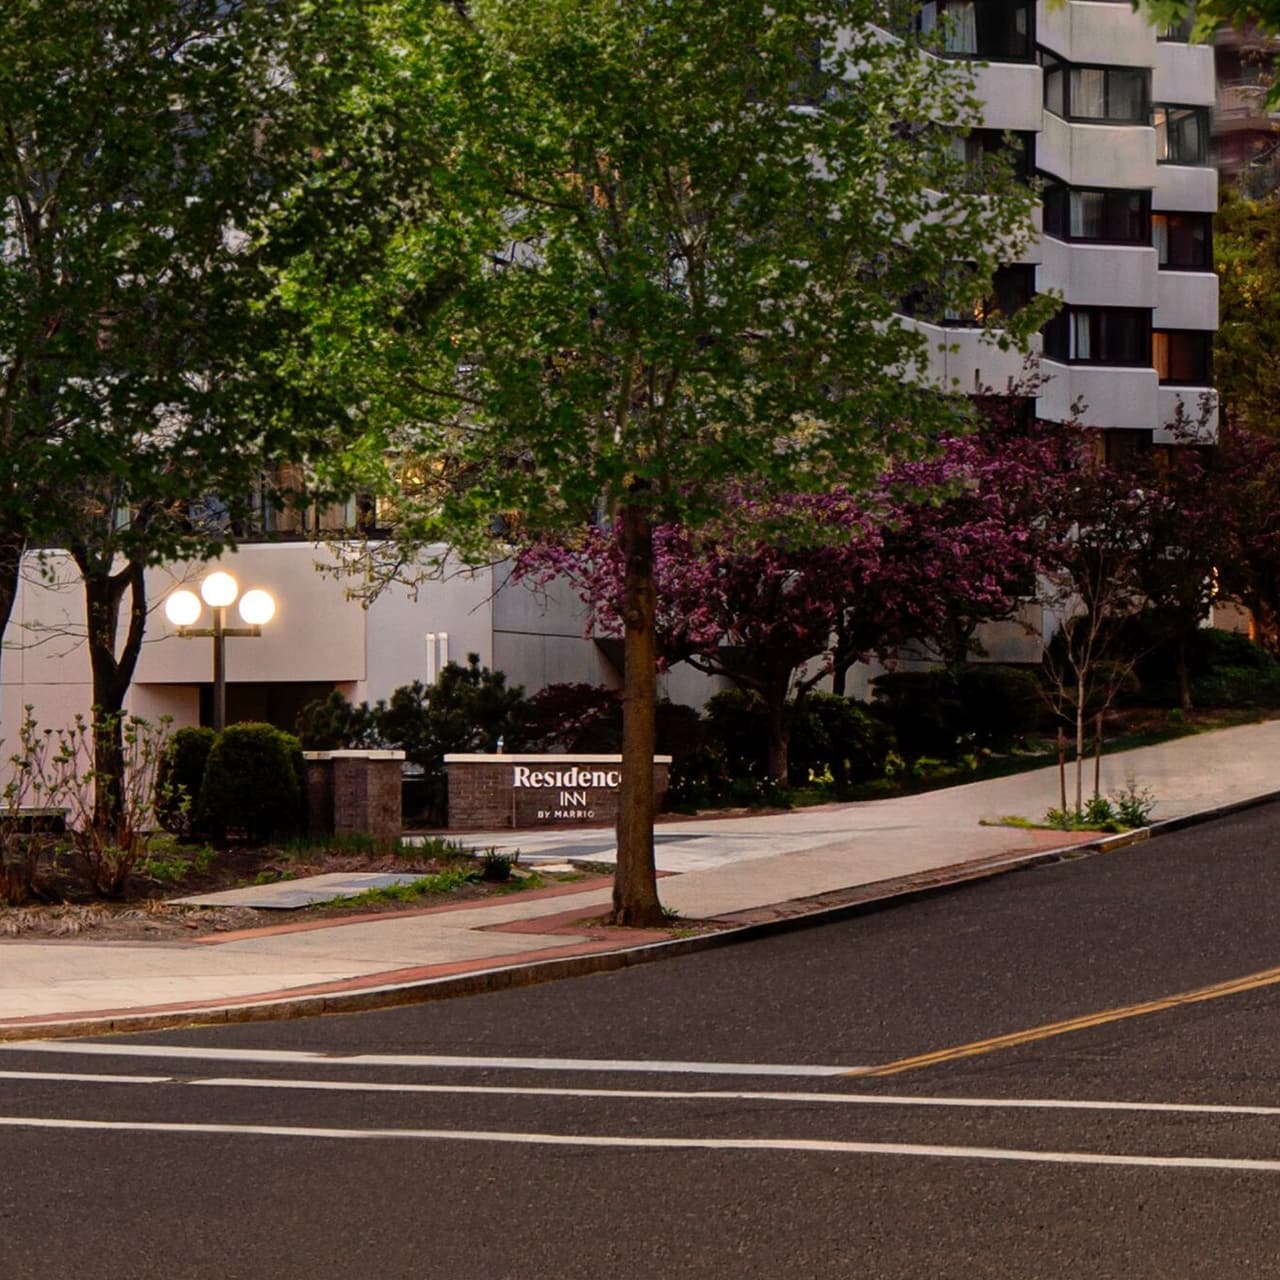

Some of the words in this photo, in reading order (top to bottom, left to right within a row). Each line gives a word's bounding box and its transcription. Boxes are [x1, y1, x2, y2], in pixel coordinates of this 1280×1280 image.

[513, 766, 622, 788] Residenc
[560, 791, 586, 807] INN
[537, 810, 551, 819] BY
